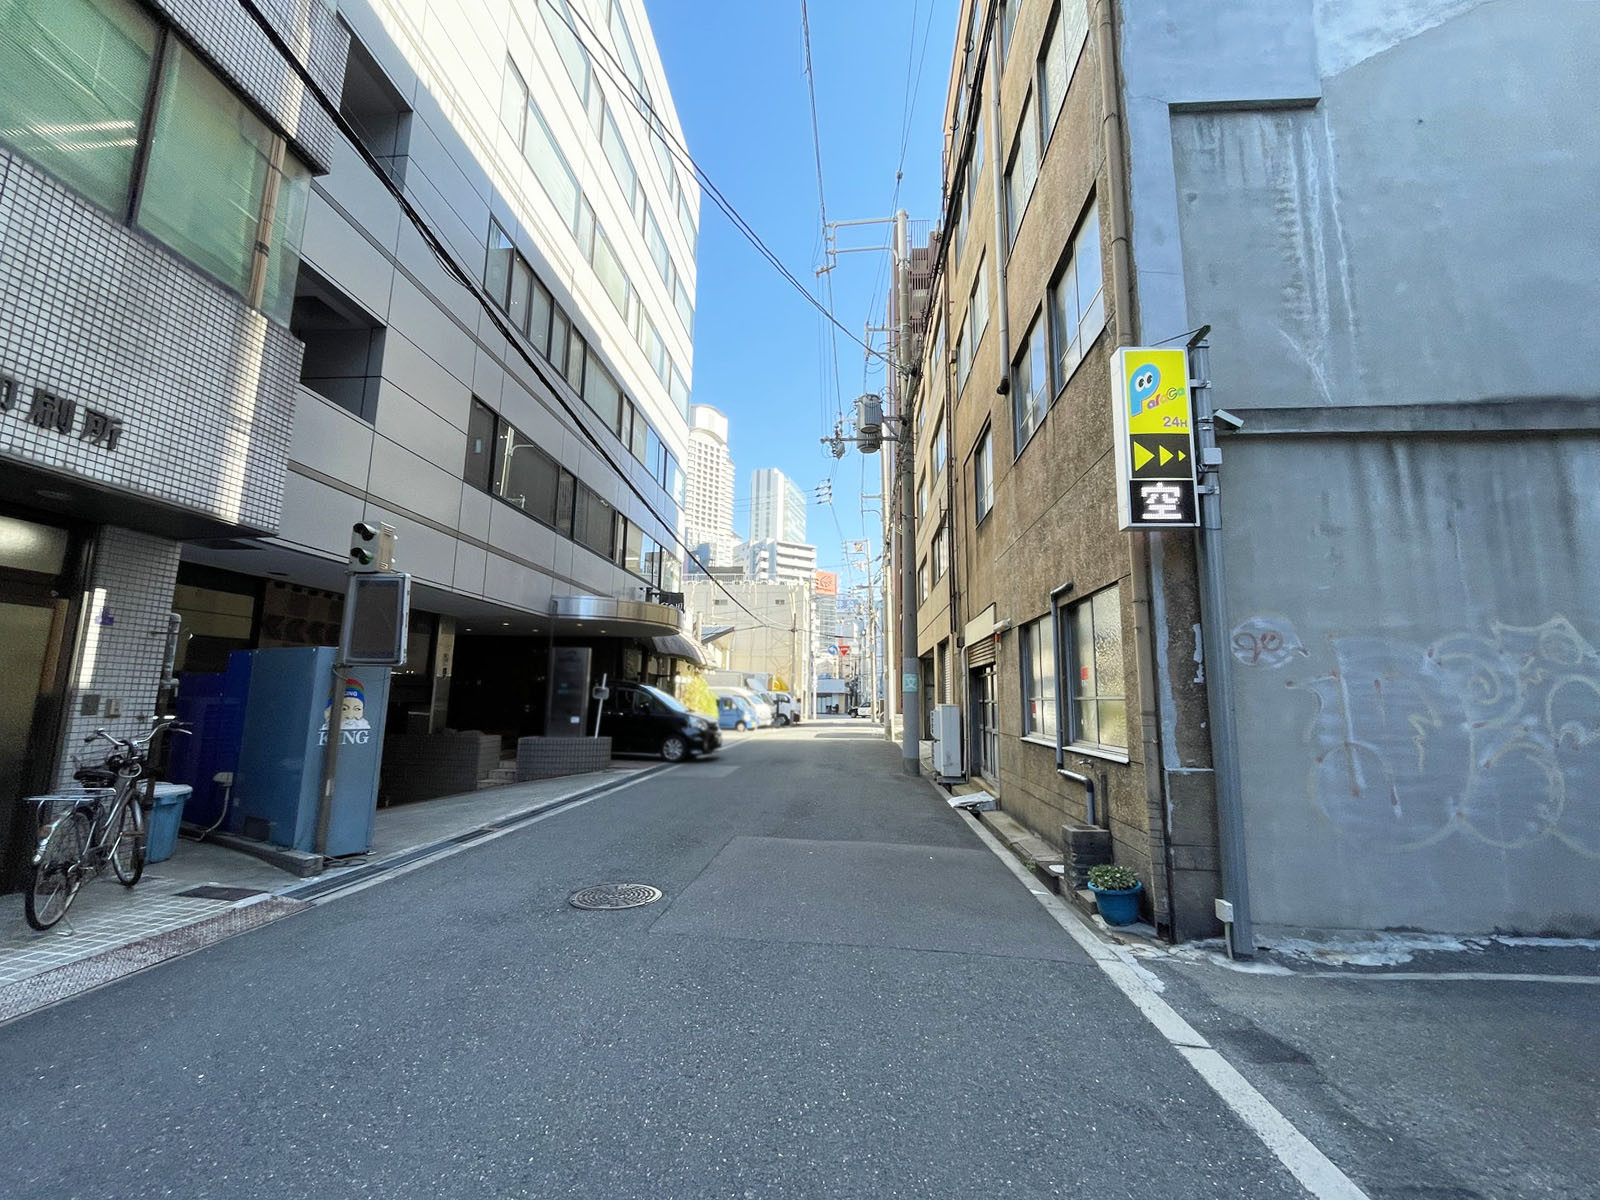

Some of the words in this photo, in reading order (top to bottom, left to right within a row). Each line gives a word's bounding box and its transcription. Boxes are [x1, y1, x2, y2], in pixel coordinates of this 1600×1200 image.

[1163, 416, 1188, 428] 24H
[1140, 481, 1182, 520] 空
[316, 730, 370, 746] KNG
